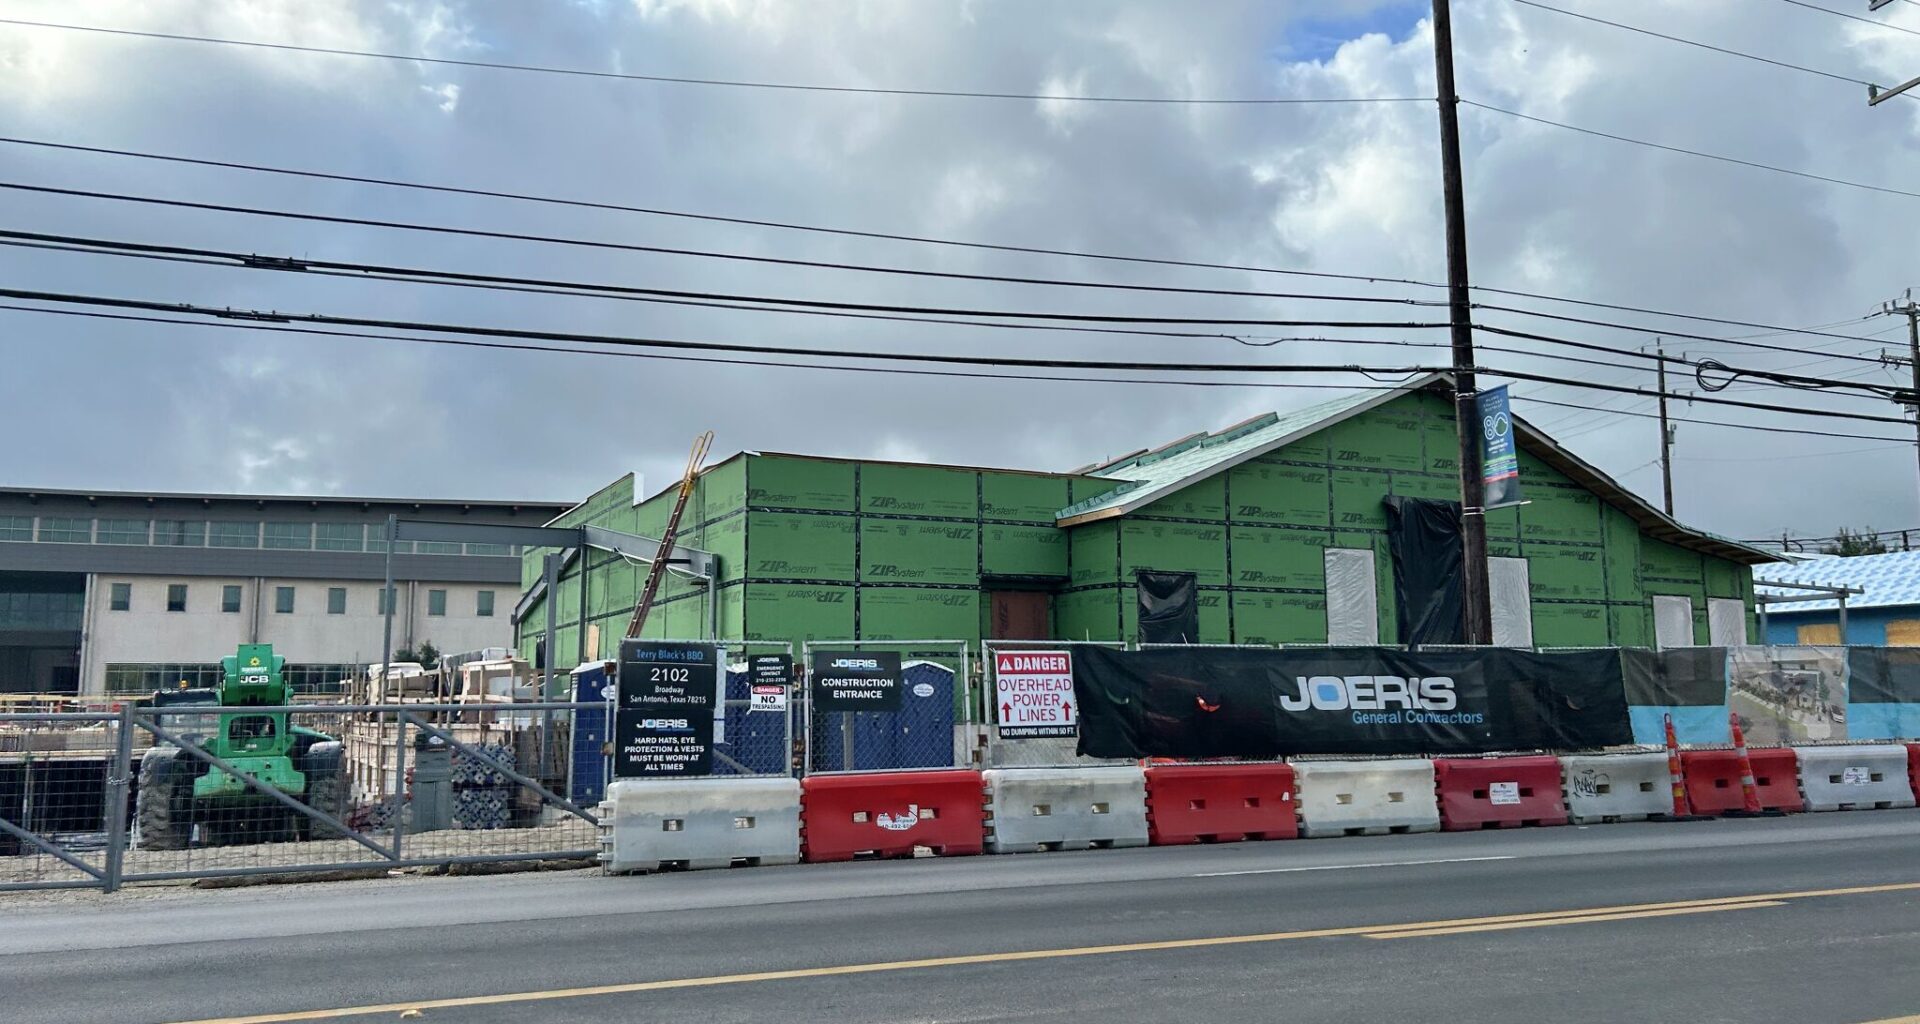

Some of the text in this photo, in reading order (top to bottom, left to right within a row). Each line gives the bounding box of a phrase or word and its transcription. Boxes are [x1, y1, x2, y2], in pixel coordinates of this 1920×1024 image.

[636, 649, 657, 662] Terry
[658, 650, 686, 660] Black's
[831, 659, 878, 668] JOERIS
[1013, 656, 1067, 671] DANGER
[240, 675, 269, 684] JCB
[650, 667, 689, 682] 2102
[821, 678, 894, 688] CONSTRUCTION
[998, 678, 1073, 692] OVERHEAD
[654, 685, 685, 695] Broadway
[833, 690, 883, 699] ENTRANCE
[1279, 675, 1457, 712] JOERIS
[630, 695, 642, 703] San
[642, 695, 669, 703] Antonio,
[687, 696, 707, 704] 78215
[760, 696, 777, 704] NO
[1012, 693, 1060, 707] POWER
[1018, 708, 1057, 722] LINES
[1352, 711, 1401, 725] General
[636, 719, 688, 729] JOERIS
[1001, 728, 1010, 736] NO
[1011, 728, 1038, 736] DUMPING
[658, 737, 680, 745] HATS,
[680, 745, 705, 753] VESTS
